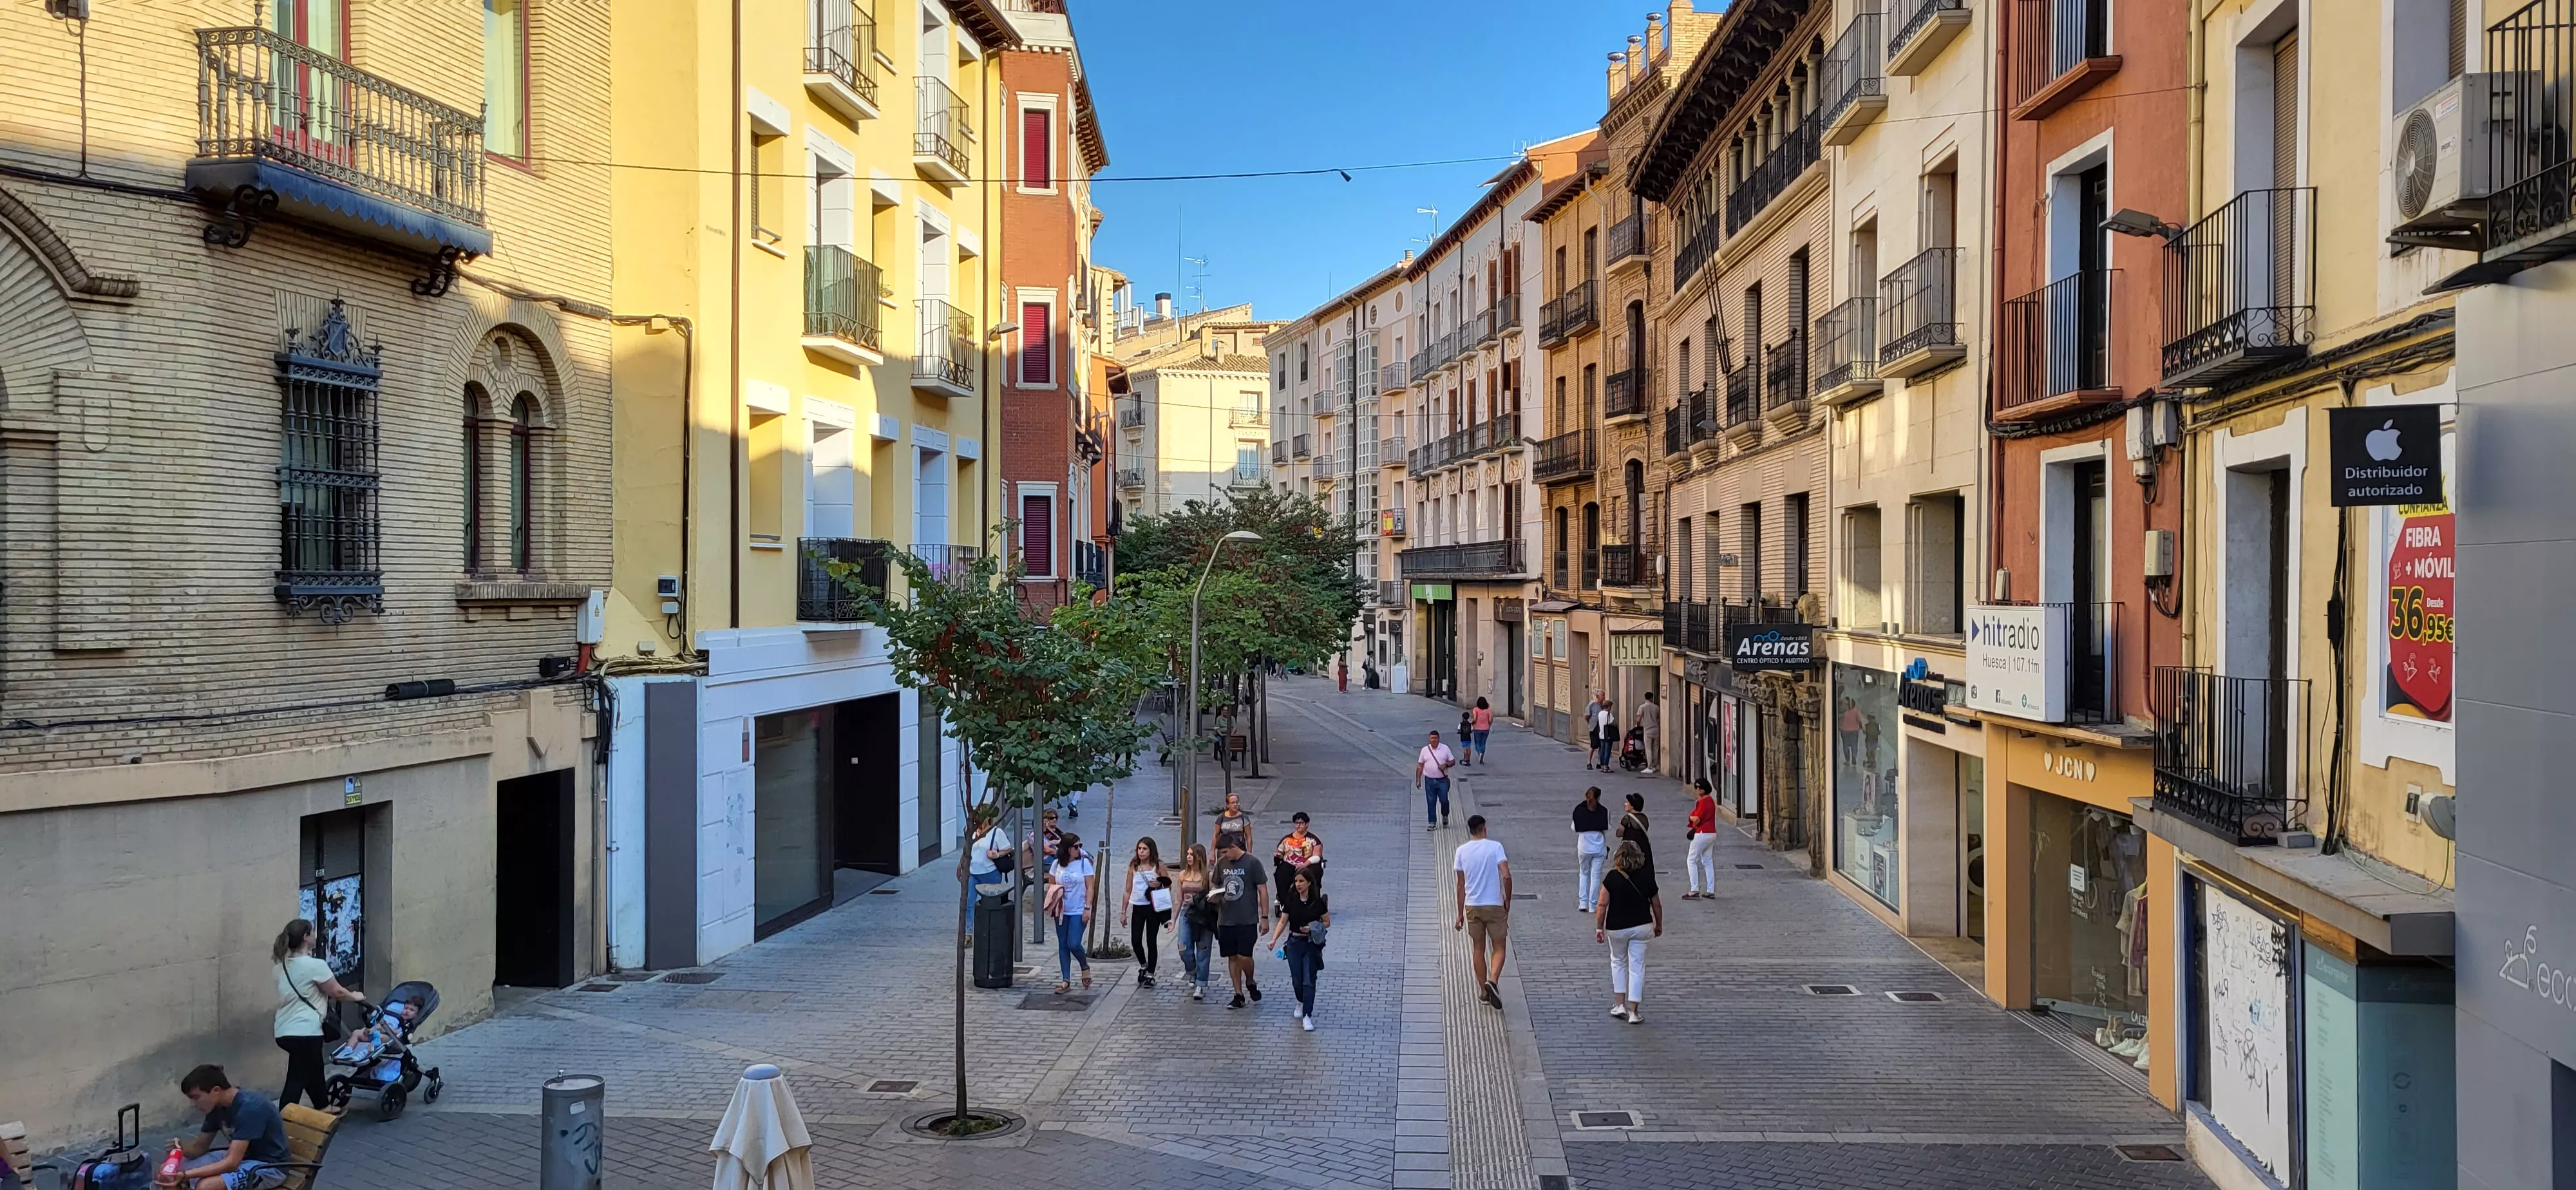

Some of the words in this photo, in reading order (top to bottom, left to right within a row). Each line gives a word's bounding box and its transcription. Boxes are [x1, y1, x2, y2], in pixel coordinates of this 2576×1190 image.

[2345, 465, 2429, 479] Distribuidor
[2348, 484, 2423, 496] autorizado
[2405, 525, 2442, 548] FIBRA
[2414, 551, 2455, 578] MÓVIL
[1983, 614, 2040, 651] hitradio
[1615, 635, 1659, 660] ASCASO
[1736, 638, 1810, 656] Arenas
[1982, 652, 2007, 670] Huesca
[2012, 657, 2040, 674] 107.1fm
[1897, 671, 1944, 715] Arenas
[2055, 755, 2084, 781] JCN
